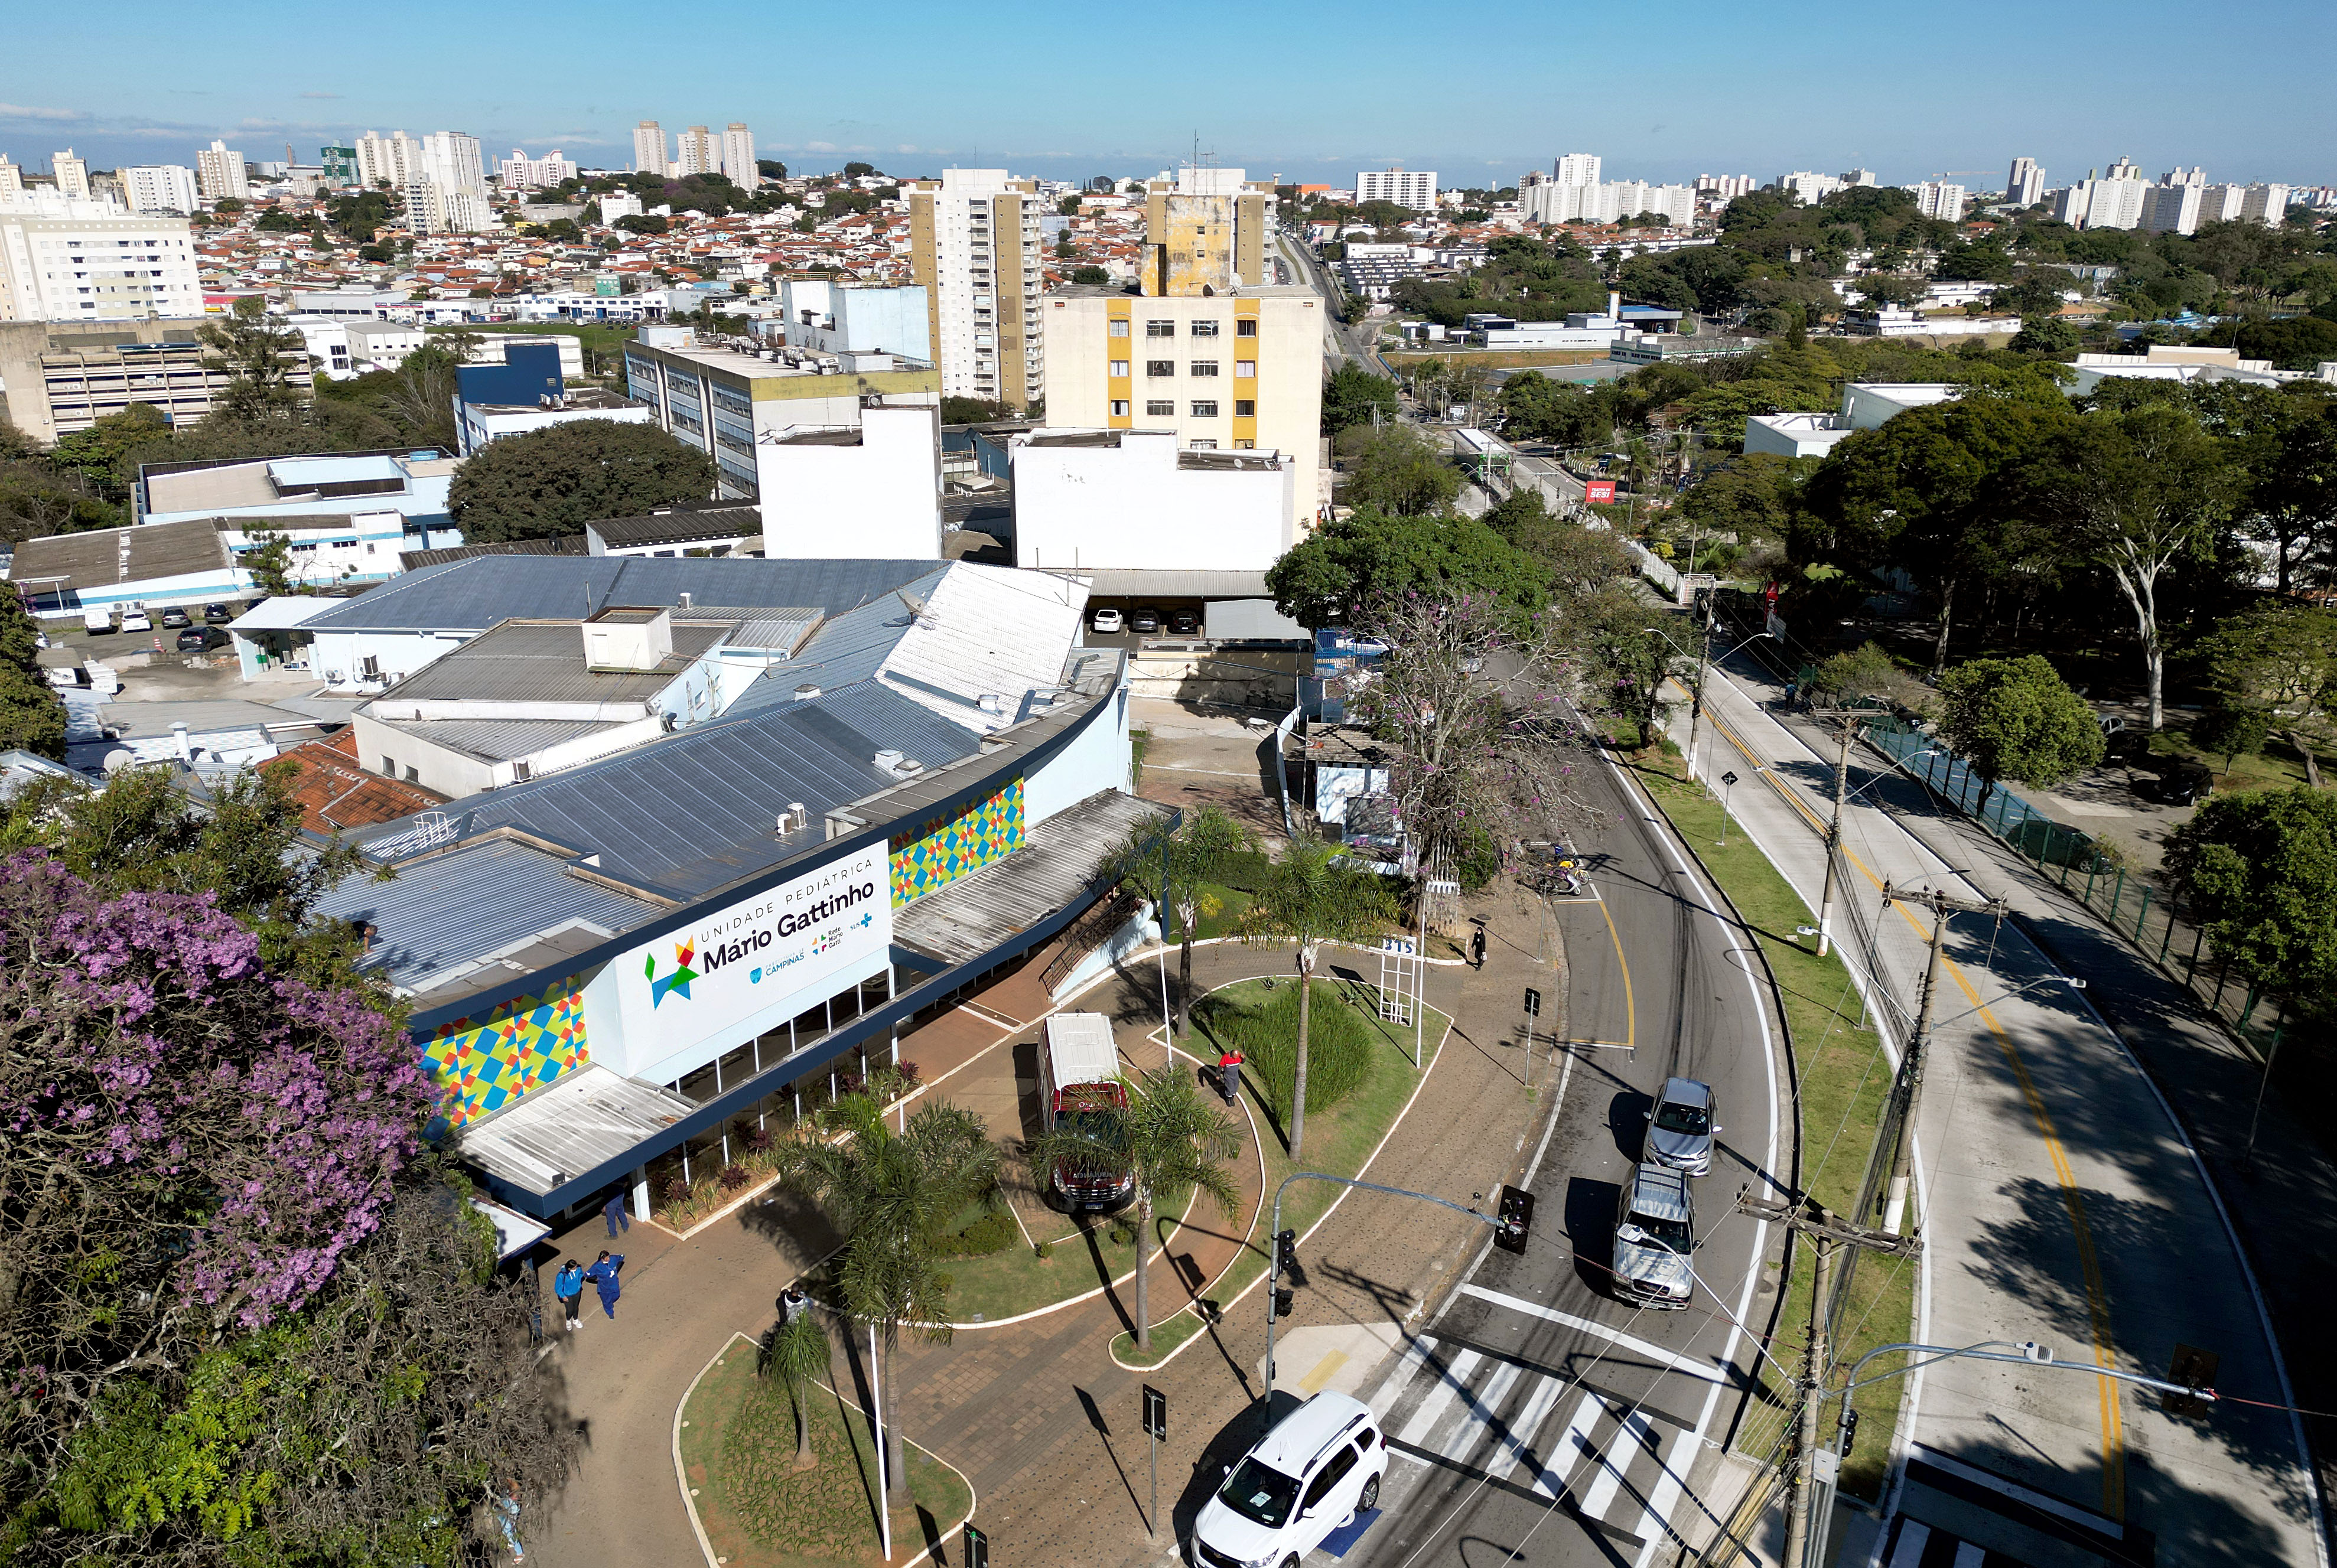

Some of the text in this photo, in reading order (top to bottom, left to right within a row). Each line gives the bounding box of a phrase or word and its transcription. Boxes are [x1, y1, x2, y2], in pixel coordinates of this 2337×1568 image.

[701, 858, 872, 943] UNIDADE PEDIÁTRICA
[703, 882, 874, 974] Mário Gattinho
[850, 922, 860, 931] SUS
[829, 938, 841, 948] Gatti
[1385, 938, 1412, 953] 315
[766, 952, 805, 976] CAMPINAS
